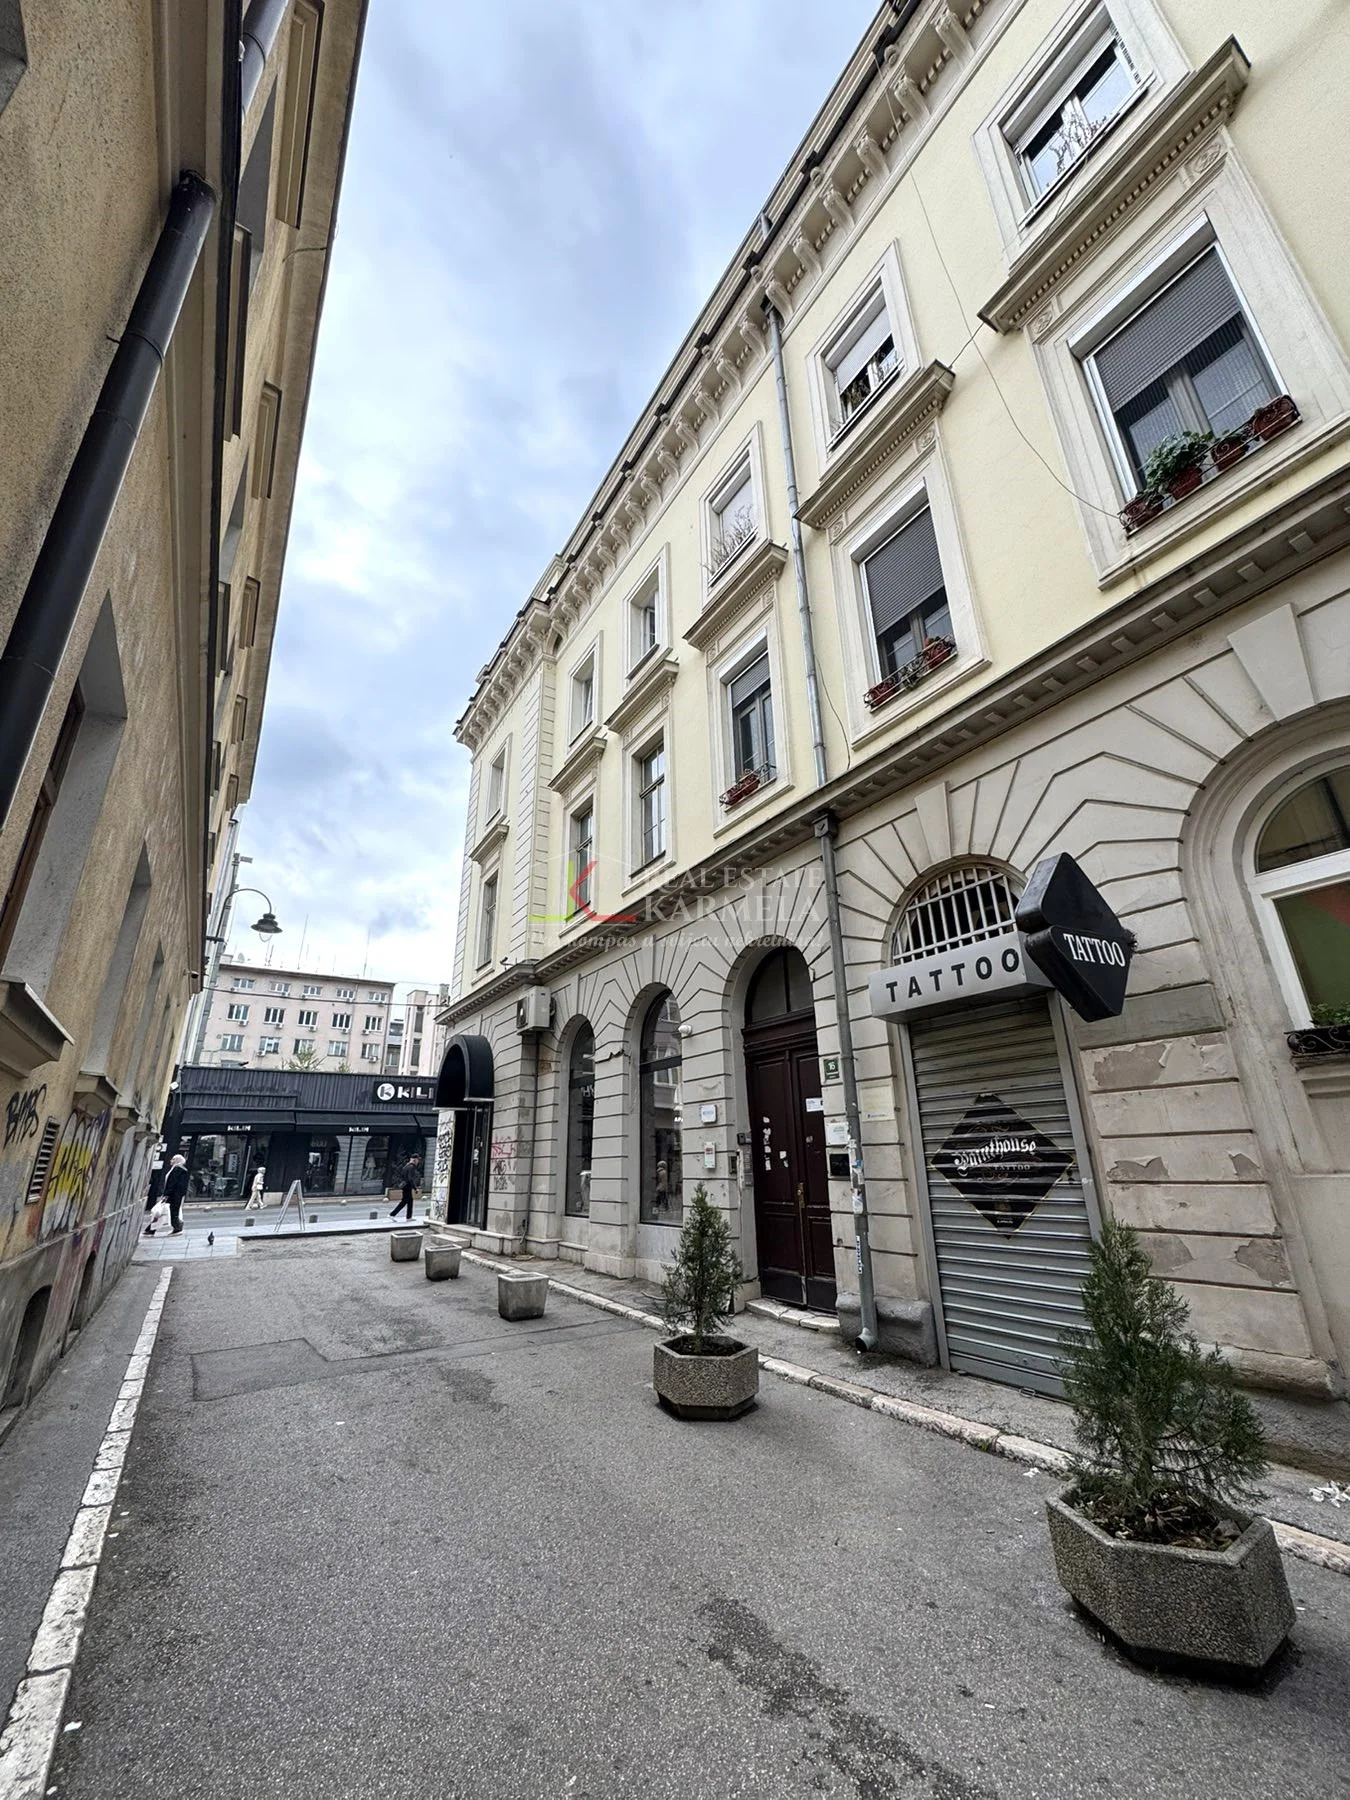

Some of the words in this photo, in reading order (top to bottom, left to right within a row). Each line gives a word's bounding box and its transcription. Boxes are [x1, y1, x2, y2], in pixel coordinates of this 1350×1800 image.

[1063, 932, 1126, 967] TATTOO
[886, 948, 1020, 1002] TATTOO
[397, 1086, 434, 1099] KILI
